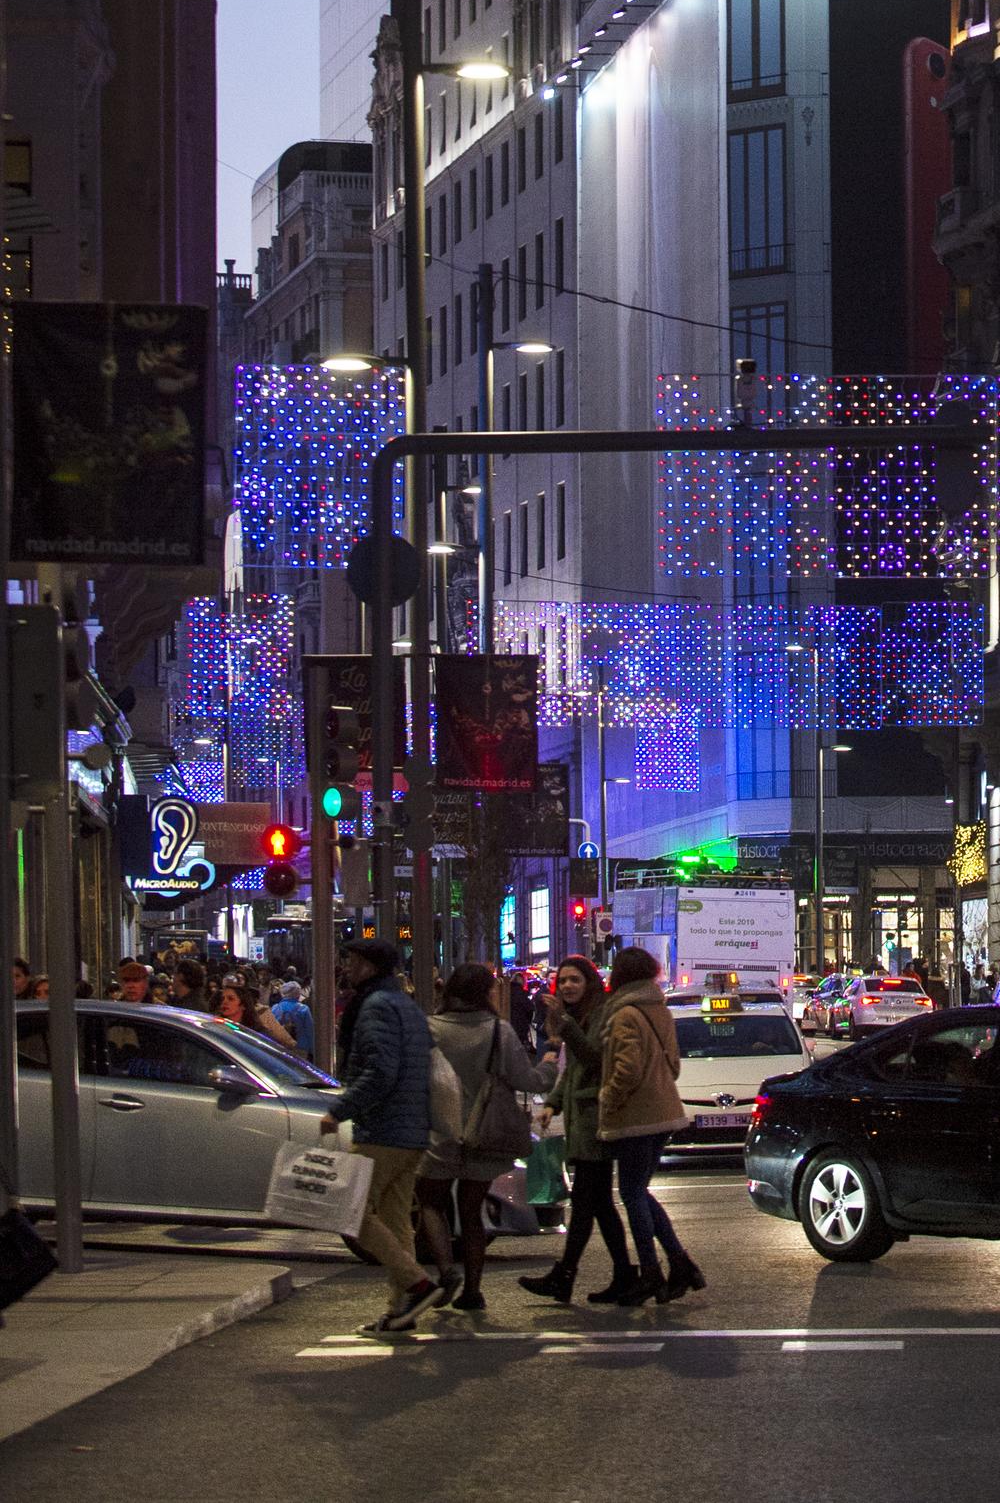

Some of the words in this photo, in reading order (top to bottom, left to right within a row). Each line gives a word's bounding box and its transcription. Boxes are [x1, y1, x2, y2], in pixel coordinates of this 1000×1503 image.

[443, 778, 532, 789] navidad.madrid.es
[737, 918, 755, 926] 2019
[690, 927, 708, 935] todo
[709, 927, 717, 935] lo
[718, 929, 732, 938] que
[743, 929, 783, 938] propongas
[711, 999, 730, 1009] TAXI
[704, 1116, 728, 1127] 3139
